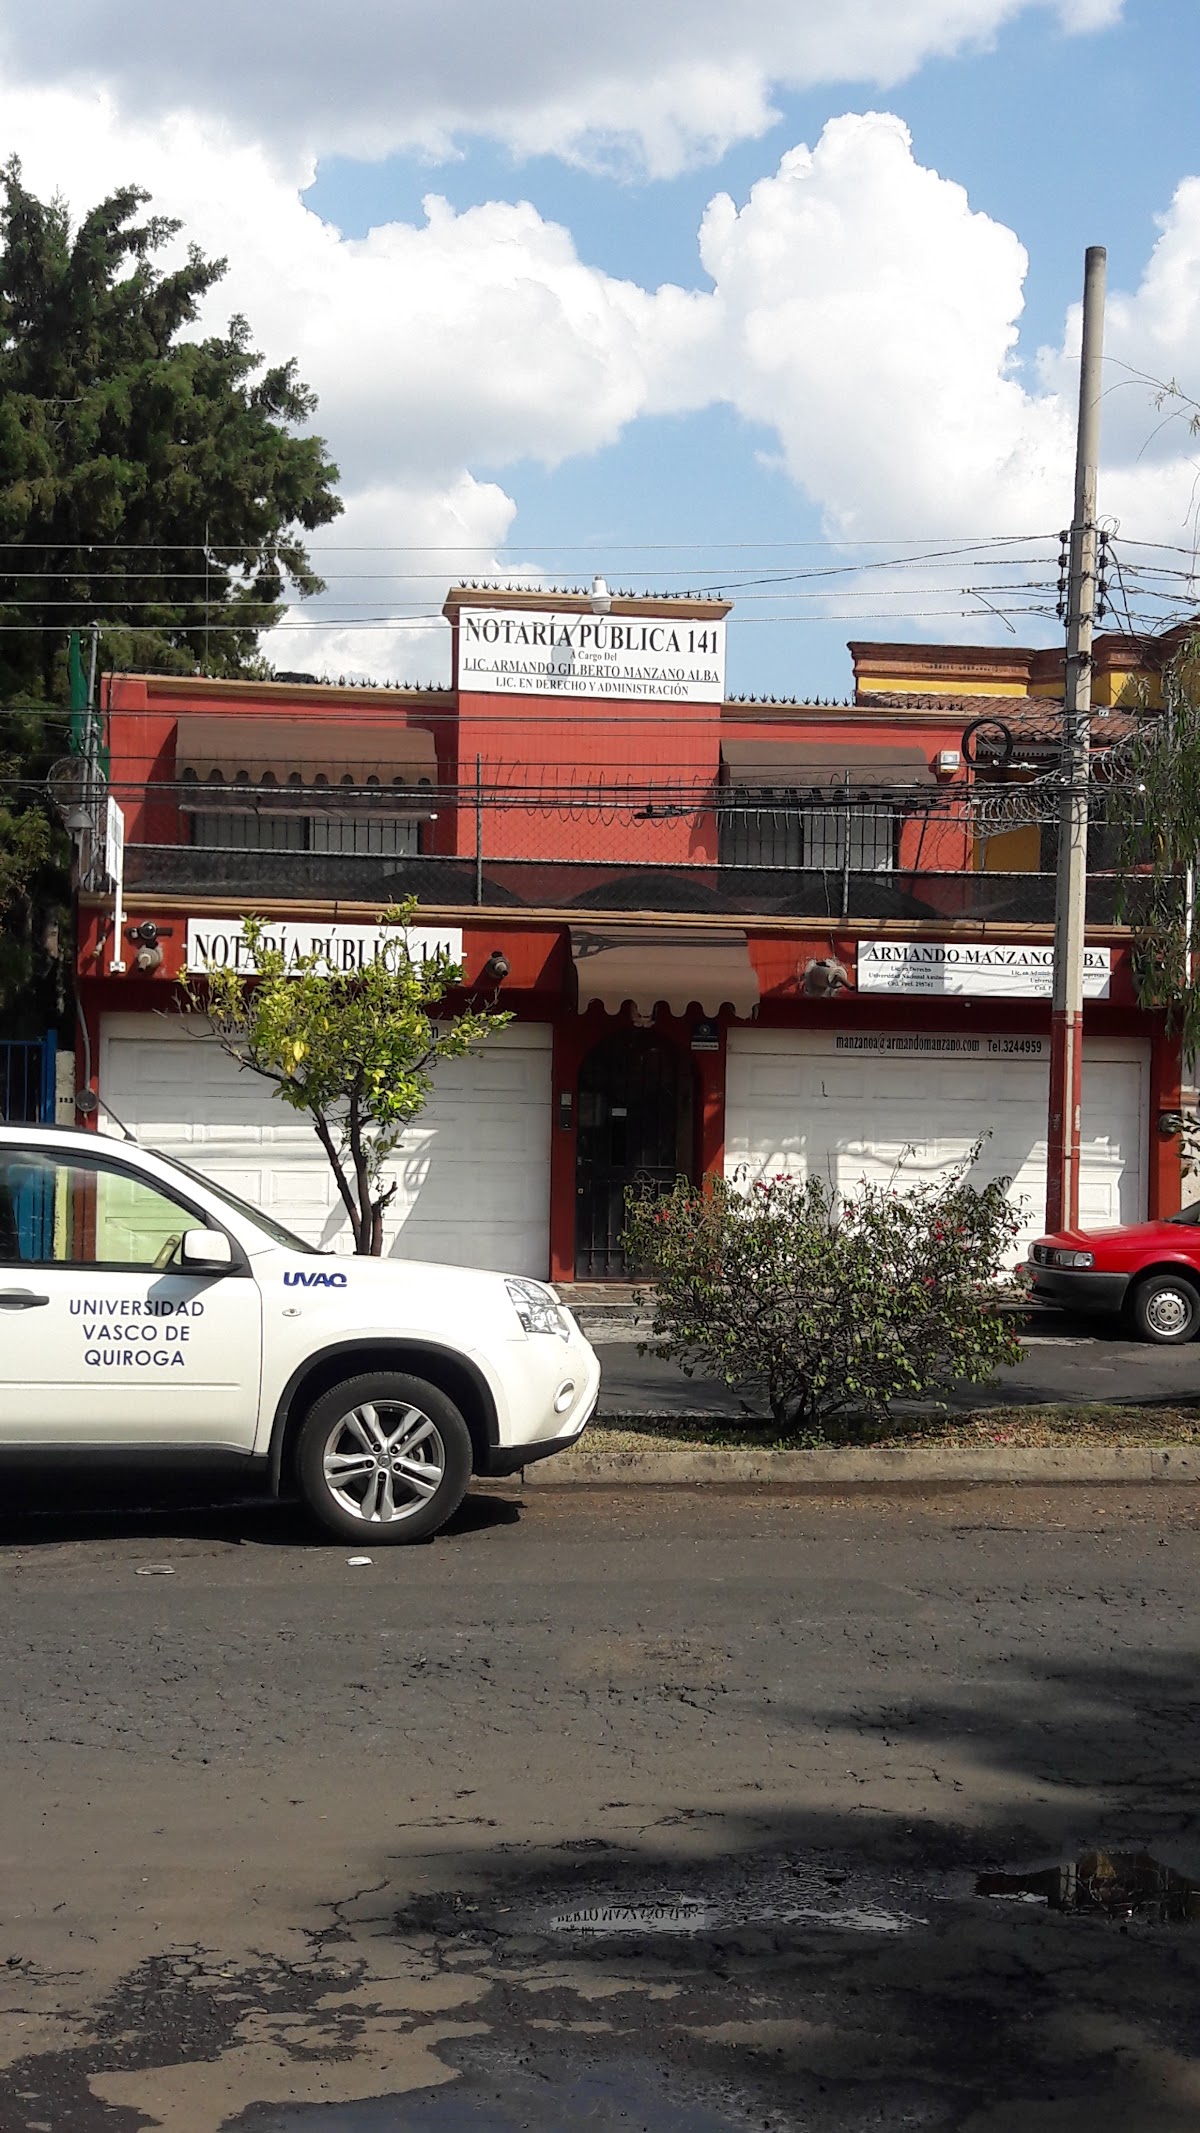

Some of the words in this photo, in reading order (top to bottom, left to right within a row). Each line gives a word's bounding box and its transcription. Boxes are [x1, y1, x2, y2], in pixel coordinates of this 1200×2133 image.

[465, 615, 573, 648] NOTARÍA
[578, 618, 681, 653] PÚBLICA
[688, 629, 718, 655] 141
[570, 650, 576, 660] A
[578, 650, 602, 663] Cargo
[604, 652, 617, 662] Del
[464, 658, 489, 671] LIC.
[491, 660, 555, 675] ARMANDO
[558, 663, 620, 678] GILBERTO
[623, 666, 685, 680] MANZANO
[687, 669, 719, 682] ALBA
[496, 677, 516, 688] LIC.
[519, 679, 533, 689] EN
[536, 679, 587, 692] DERECHO
[588, 682, 596, 692] Y
[597, 683, 689, 696] ADMINISTRACIÓN
[867, 946, 960, 963] ARMANDO
[965, 950, 1054, 966] MANZANO
[283, 1272, 347, 1287] UVAQ
[69, 1300, 204, 1317] UNIVERSIDAD
[82, 1324, 158, 1341] VASCO
[165, 1326, 190, 1341] DE
[84, 1350, 185, 1367] QUIROGA
